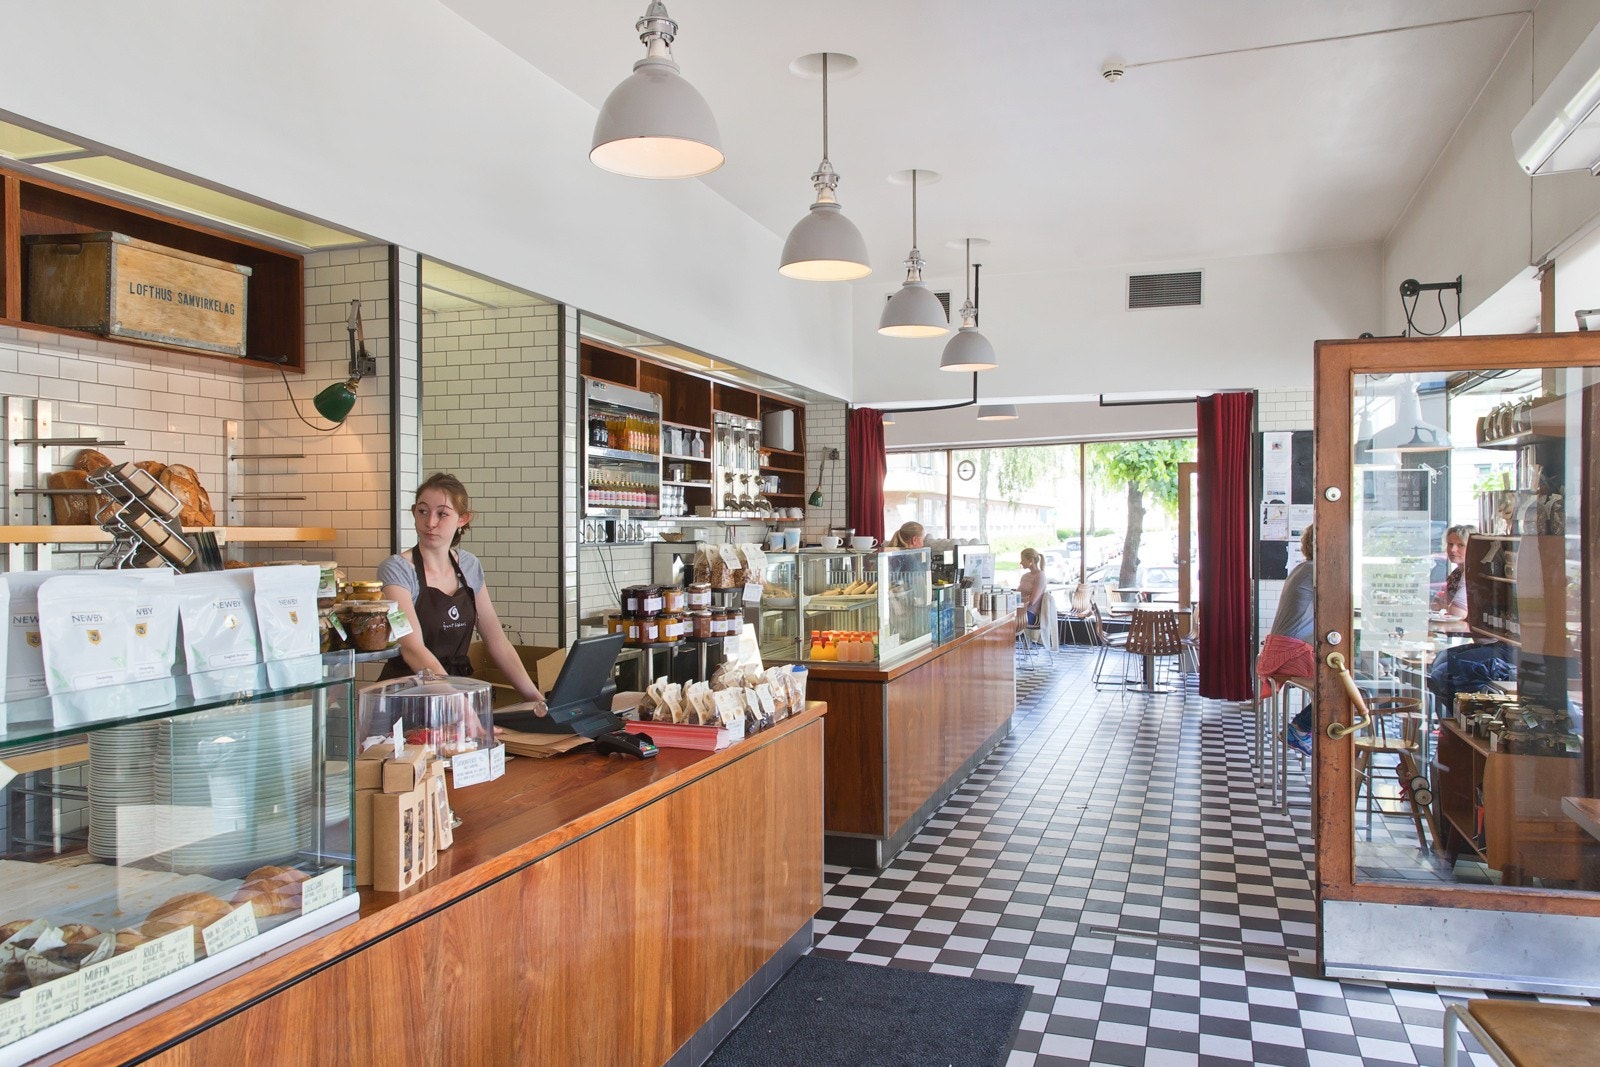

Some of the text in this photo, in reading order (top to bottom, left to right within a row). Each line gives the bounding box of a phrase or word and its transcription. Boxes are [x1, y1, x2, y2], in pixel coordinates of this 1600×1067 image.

[129, 281, 235, 315] LOFTHUS SAMVIRKELAG
[212, 600, 242, 609] NEWBY
[278, 598, 298, 606] NEWBY
[71, 614, 104, 623] NEWBY
[84, 964, 110, 983] MUFFIN
